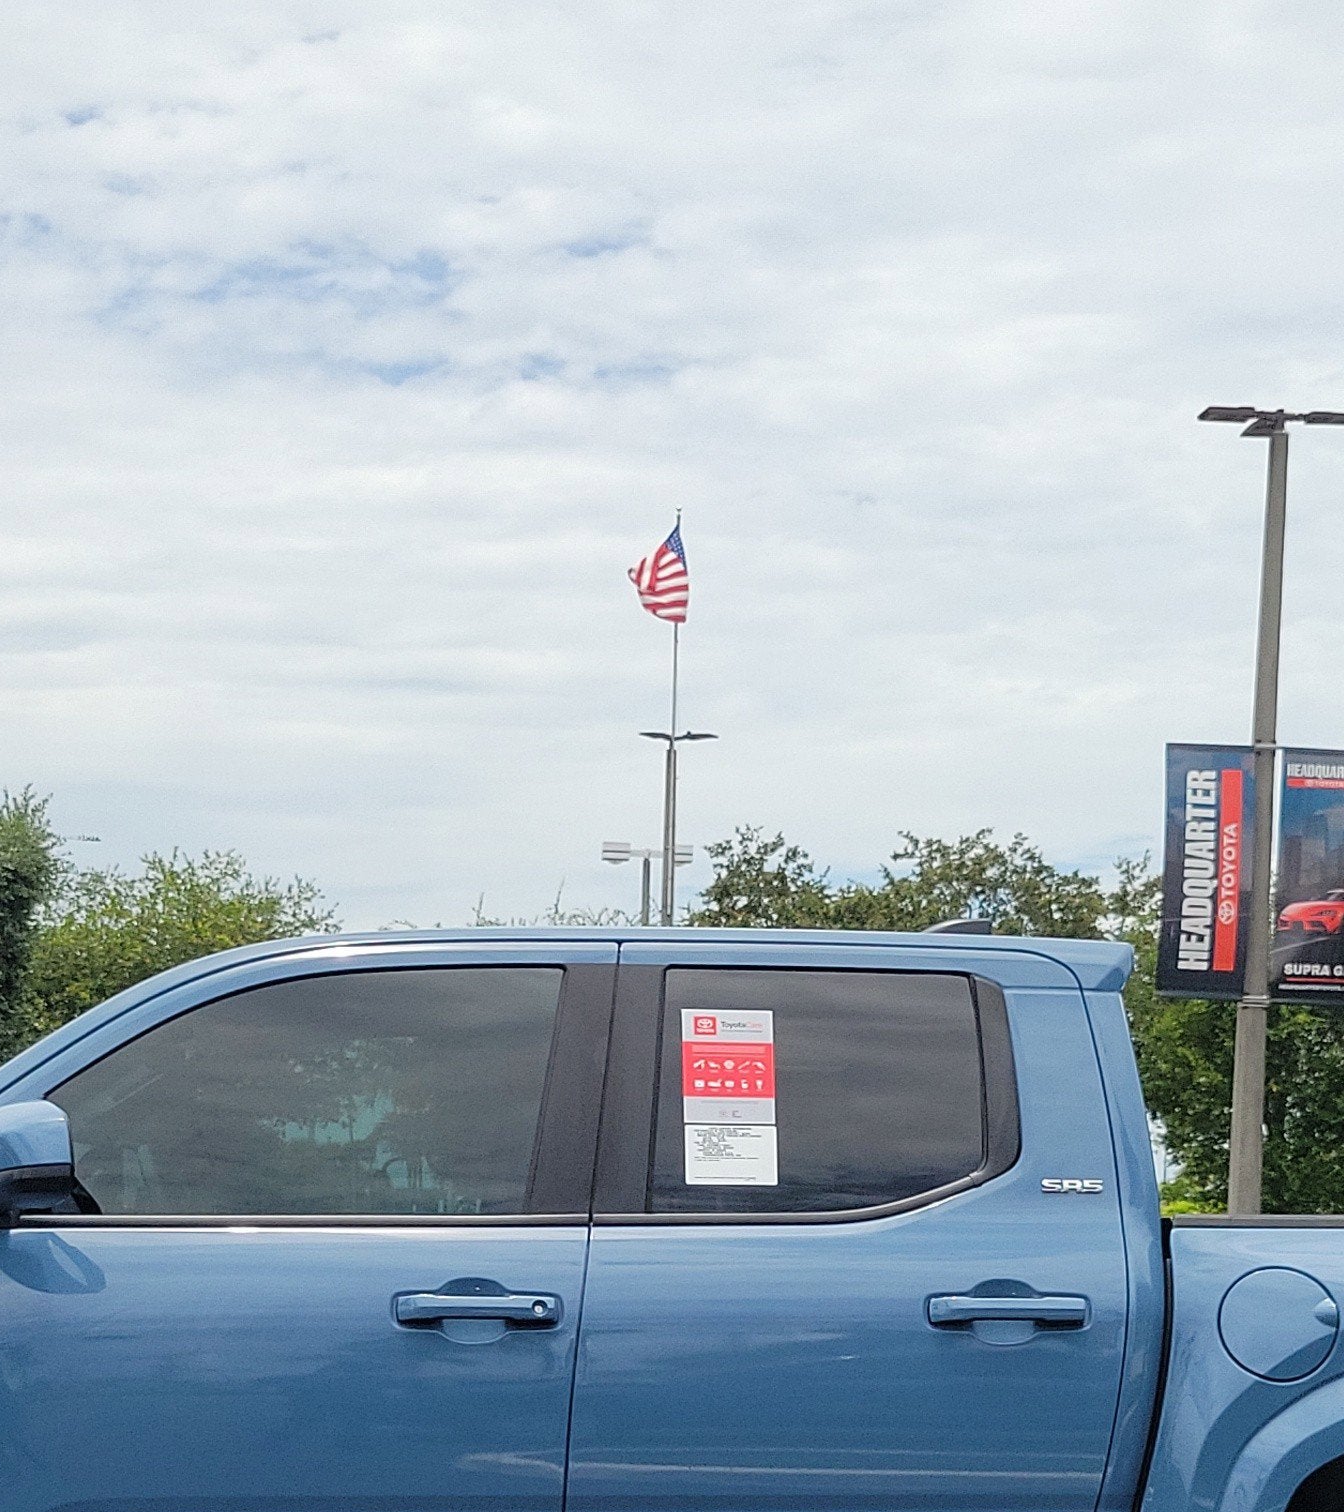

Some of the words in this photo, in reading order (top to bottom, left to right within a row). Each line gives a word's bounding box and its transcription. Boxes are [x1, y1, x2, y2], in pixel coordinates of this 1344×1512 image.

[1177, 769, 1218, 971] HEADQUARTER
[1221, 822, 1238, 899] TOYOTA
[1283, 962, 1331, 976] SUPRA
[1041, 1178, 1104, 1193] SR5
